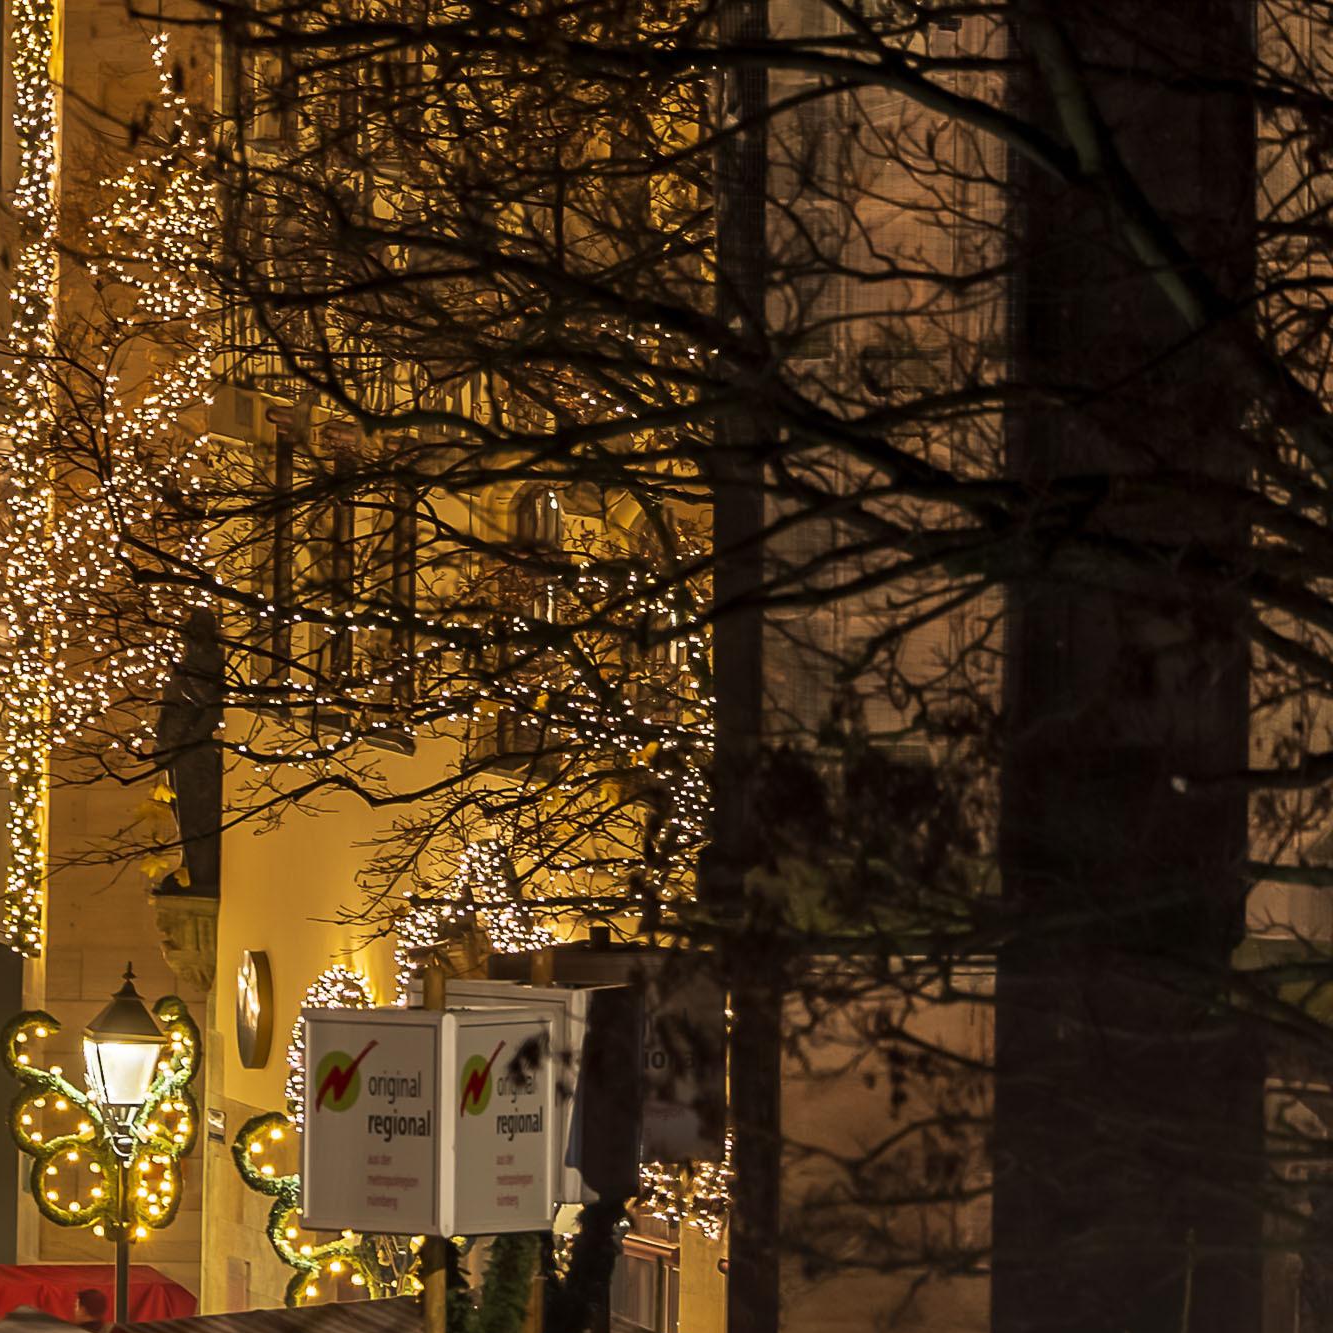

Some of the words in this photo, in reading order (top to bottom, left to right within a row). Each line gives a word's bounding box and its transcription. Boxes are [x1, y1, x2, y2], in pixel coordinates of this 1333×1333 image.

[368, 1070, 422, 1104] original
[367, 1108, 432, 1143] regional
[496, 1106, 544, 1141] regional
